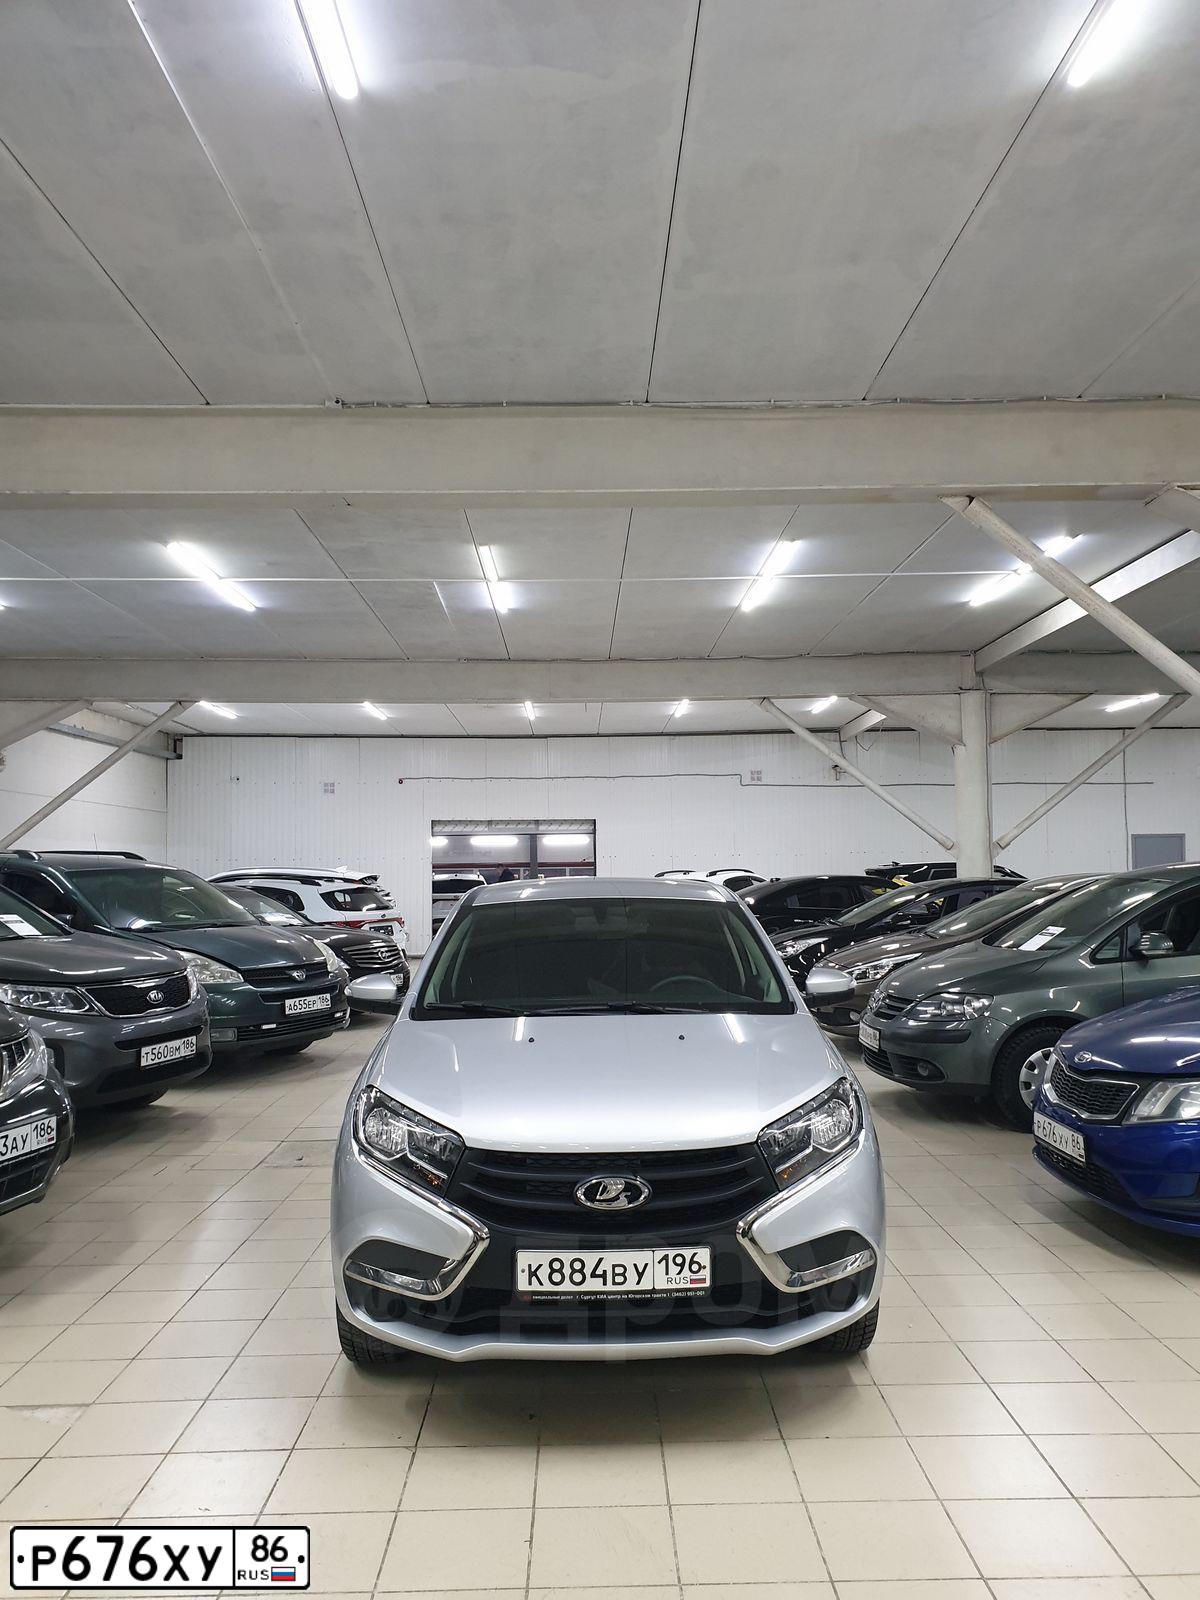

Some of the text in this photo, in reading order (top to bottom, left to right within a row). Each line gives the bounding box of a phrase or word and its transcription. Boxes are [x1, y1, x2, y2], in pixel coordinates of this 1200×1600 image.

[288, 999, 317, 1012] А655ЕР
[144, 1038, 194, 1063] Т560ВМ 186
[33, 1119, 53, 1139] 186
[1071, 1133, 1081, 1150] 86
[527, 1252, 701, 1286] К884ВУ 196
[666, 1276, 689, 1285] RUS
